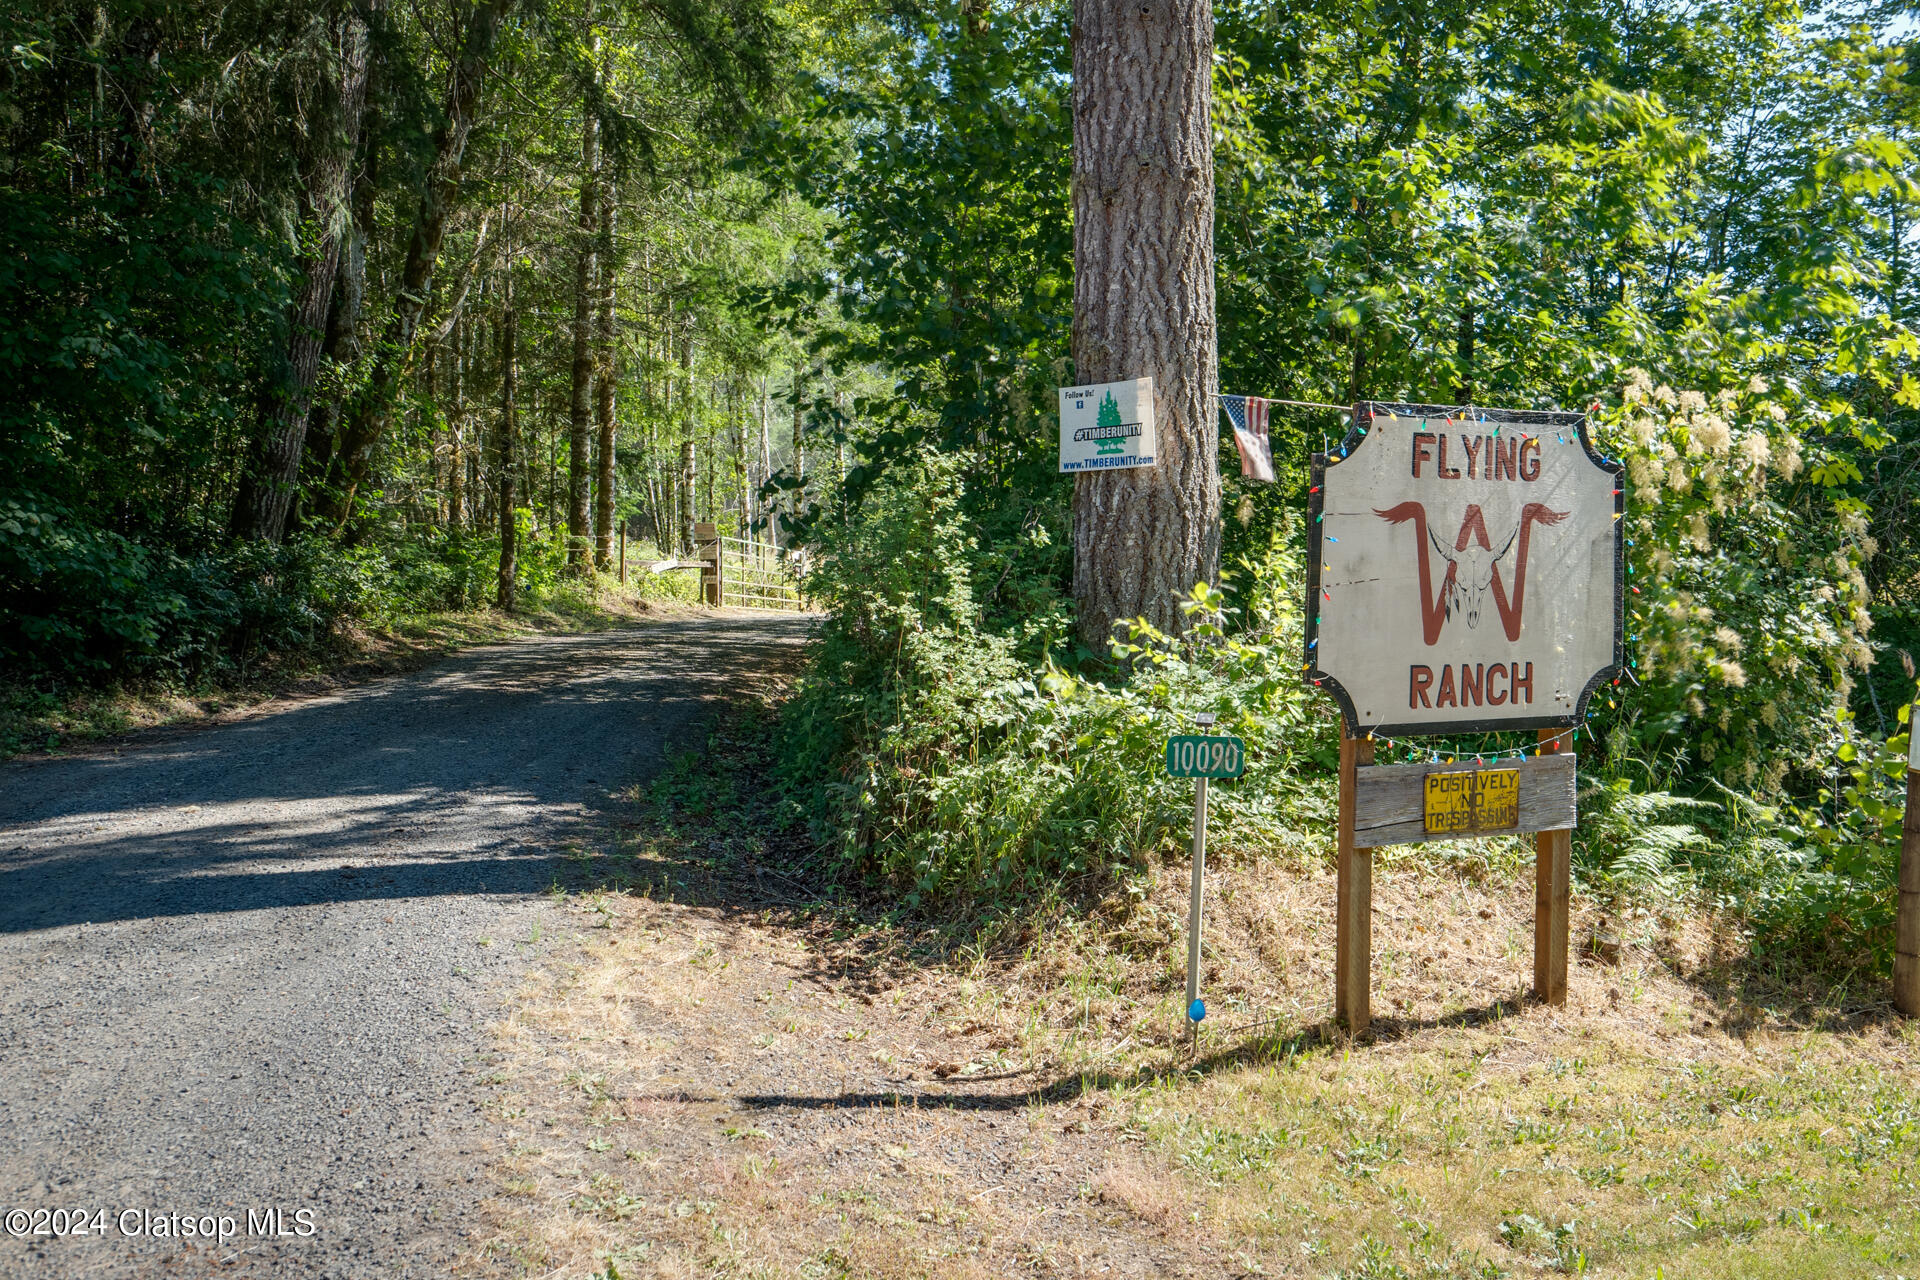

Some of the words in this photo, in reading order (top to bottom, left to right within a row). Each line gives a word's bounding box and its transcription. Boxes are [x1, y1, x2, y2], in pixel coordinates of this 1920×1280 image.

[1064, 391, 1084, 400] Follow
[1074, 423, 1143, 442] #TIMBERUNITY
[1063, 455, 1154, 470] www.TIMBERUNITY.com
[1411, 432, 1541, 482] FLYING
[1409, 662, 1533, 709] RANCH
[1173, 741, 1239, 773] 10090
[1430, 773, 1517, 793] POSITIVELY
[1461, 792, 1485, 808] NO
